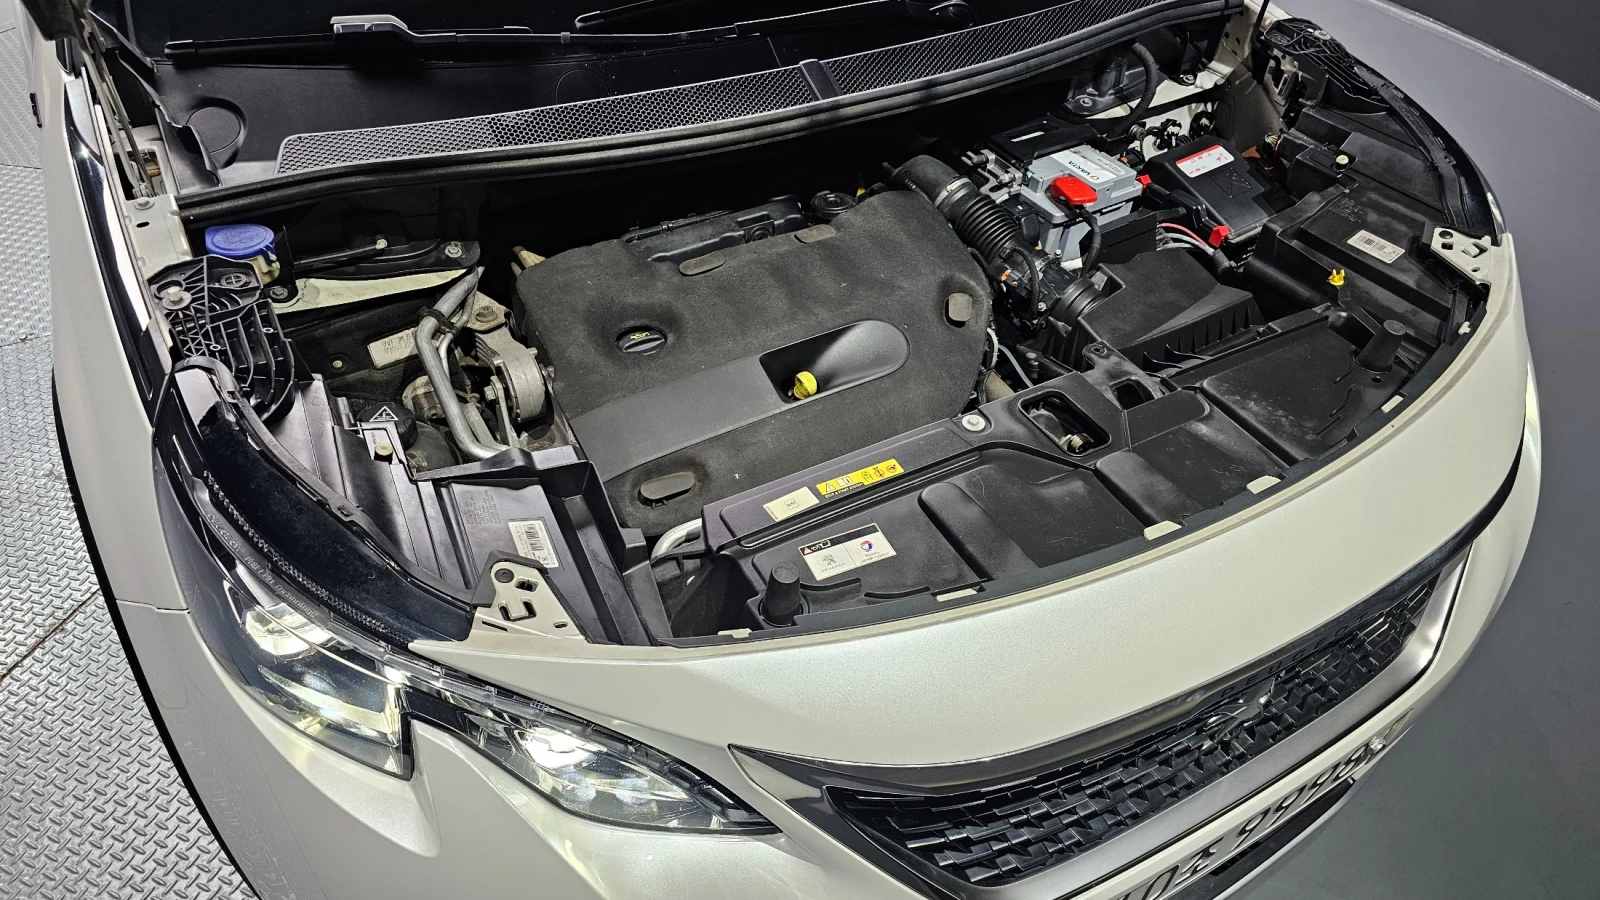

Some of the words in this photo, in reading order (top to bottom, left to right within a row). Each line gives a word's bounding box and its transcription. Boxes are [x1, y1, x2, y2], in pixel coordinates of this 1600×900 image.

[1068, 160, 1090, 175] VARTA
[207, 512, 244, 553] PEUGEOT
[1117, 836, 1224, 900] 0조
